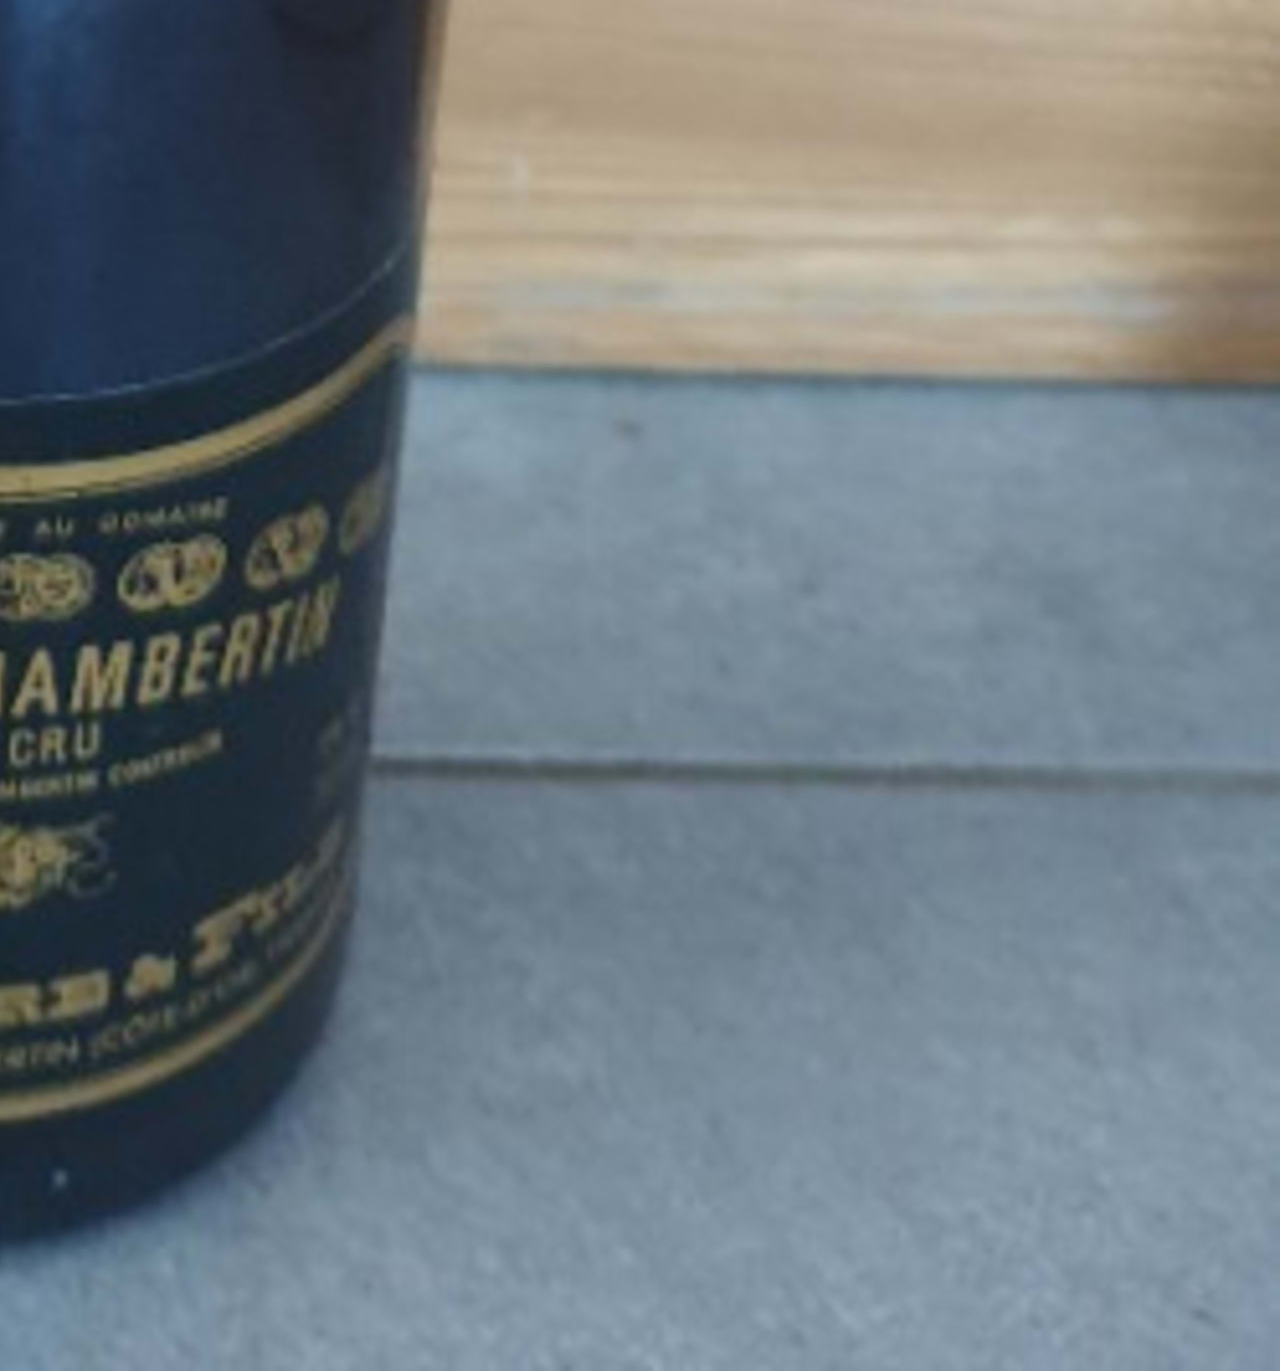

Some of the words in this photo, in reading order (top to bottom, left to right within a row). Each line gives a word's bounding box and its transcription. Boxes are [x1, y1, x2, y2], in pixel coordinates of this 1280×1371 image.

[35, 514, 75, 538] AU
[7, 721, 102, 767] CRU
[124, 953, 178, 999] &
